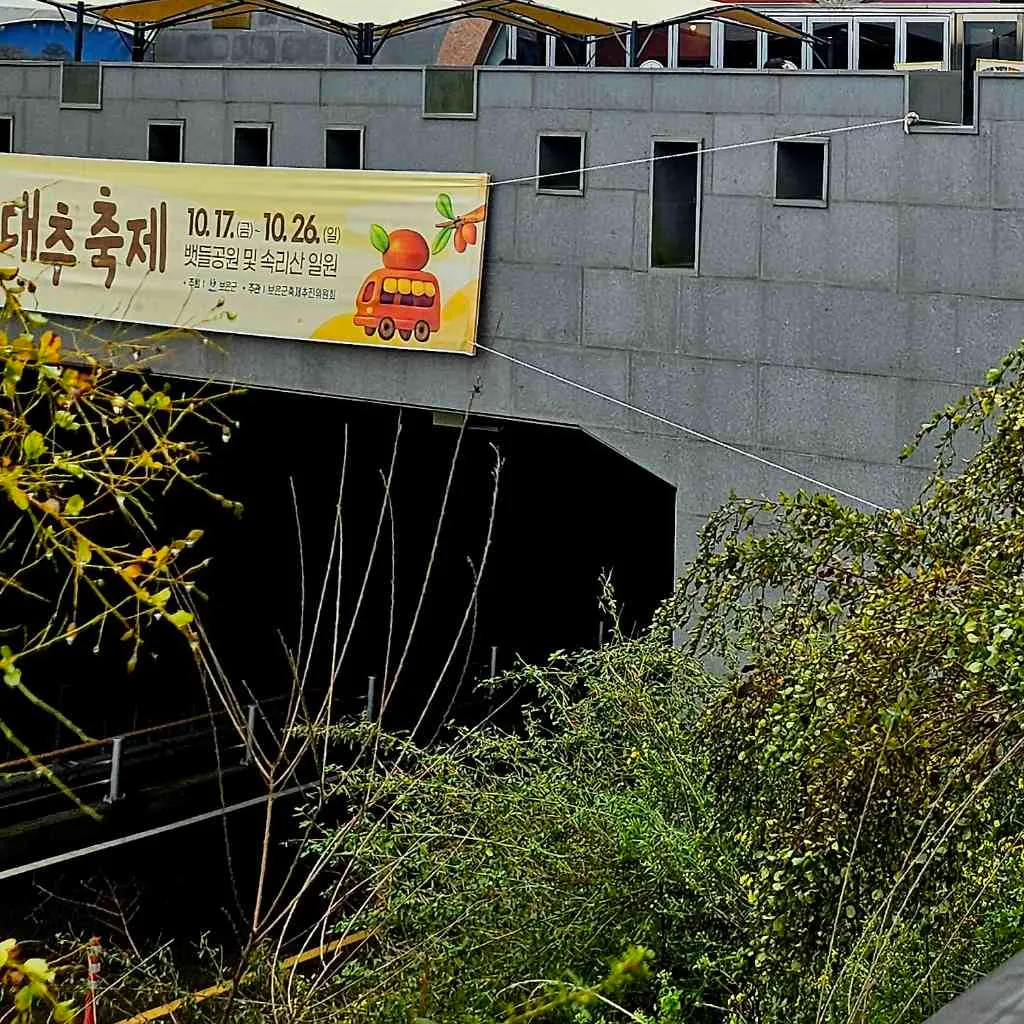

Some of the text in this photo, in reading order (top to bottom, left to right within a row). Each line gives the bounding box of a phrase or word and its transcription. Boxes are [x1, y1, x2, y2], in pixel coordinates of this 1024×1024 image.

[1, 186, 167, 289] 대추축제
[184, 244, 338, 277] 뱃들공원 및 속리산 일원
